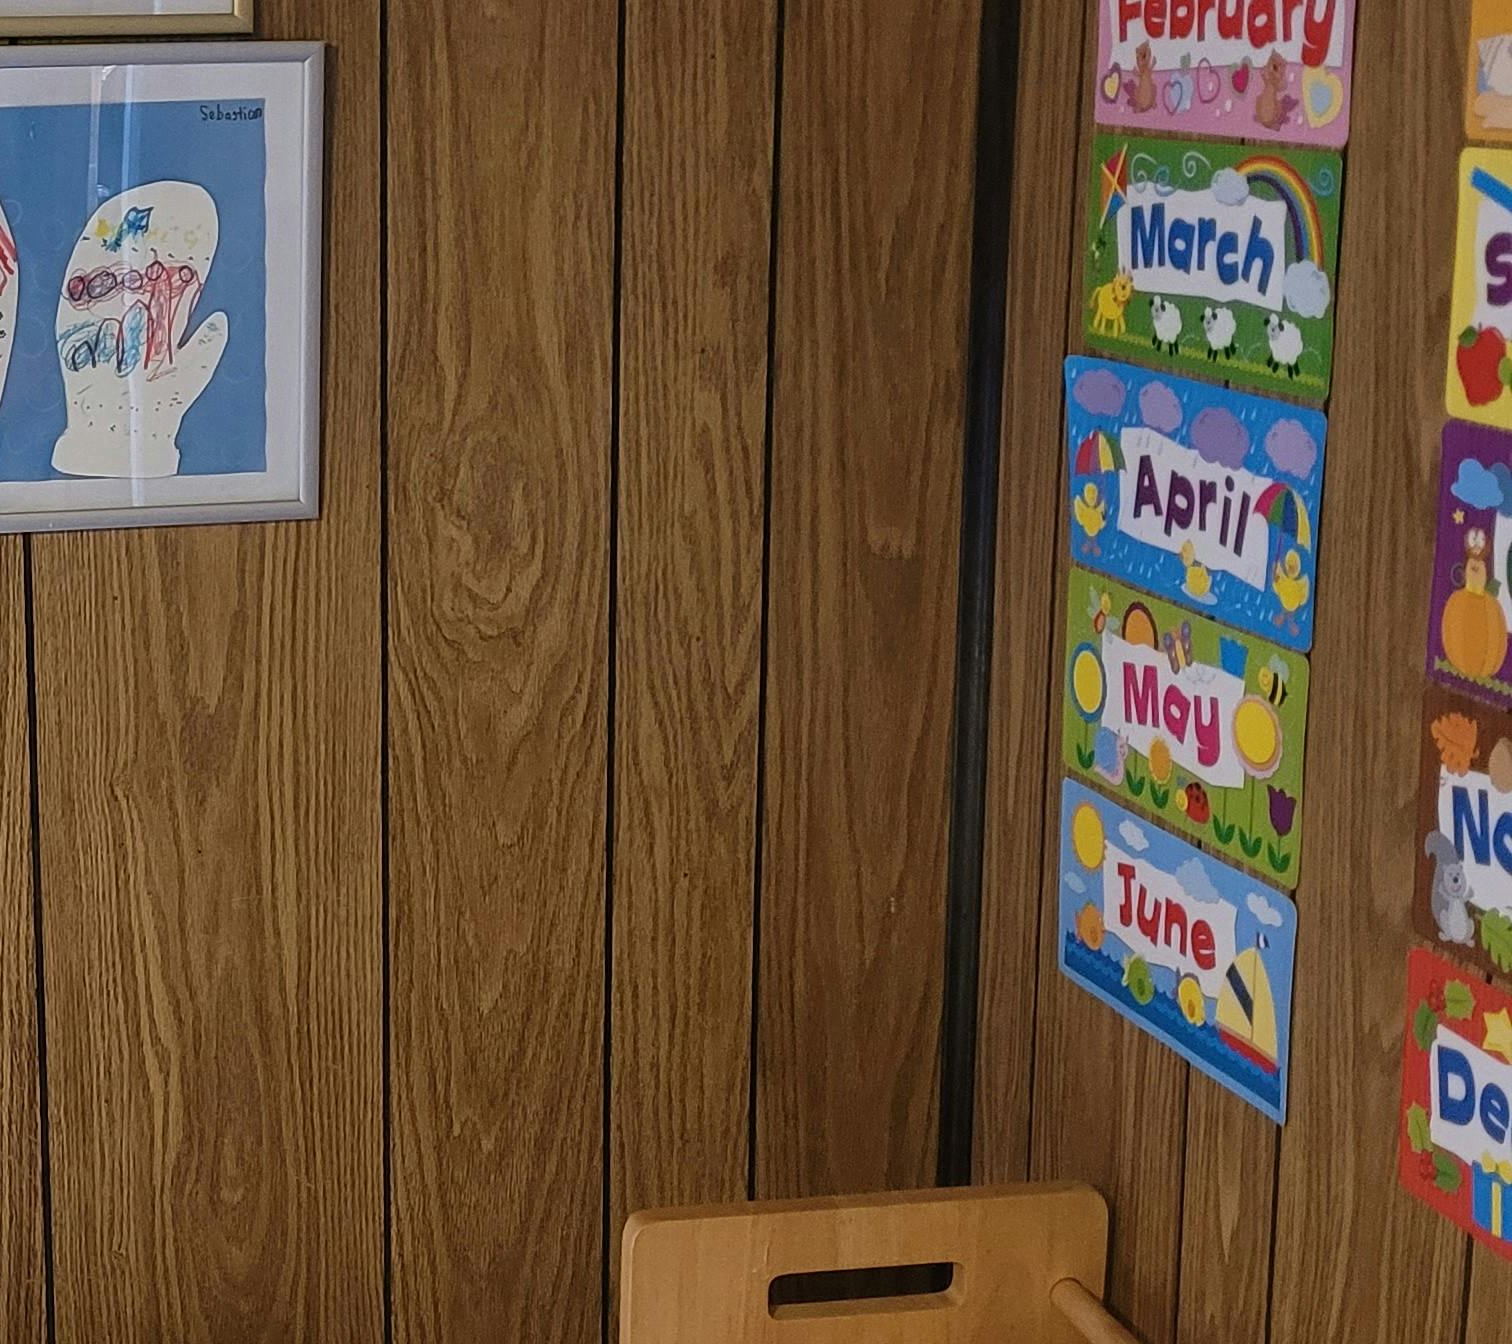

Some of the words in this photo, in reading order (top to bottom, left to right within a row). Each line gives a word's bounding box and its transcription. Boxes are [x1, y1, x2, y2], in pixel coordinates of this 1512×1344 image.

[199, 103, 263, 121] Sebastian
[1129, 203, 1276, 297] March
[1133, 453, 1254, 558] April
[1121, 661, 1222, 770] May
[1116, 861, 1217, 972] June
